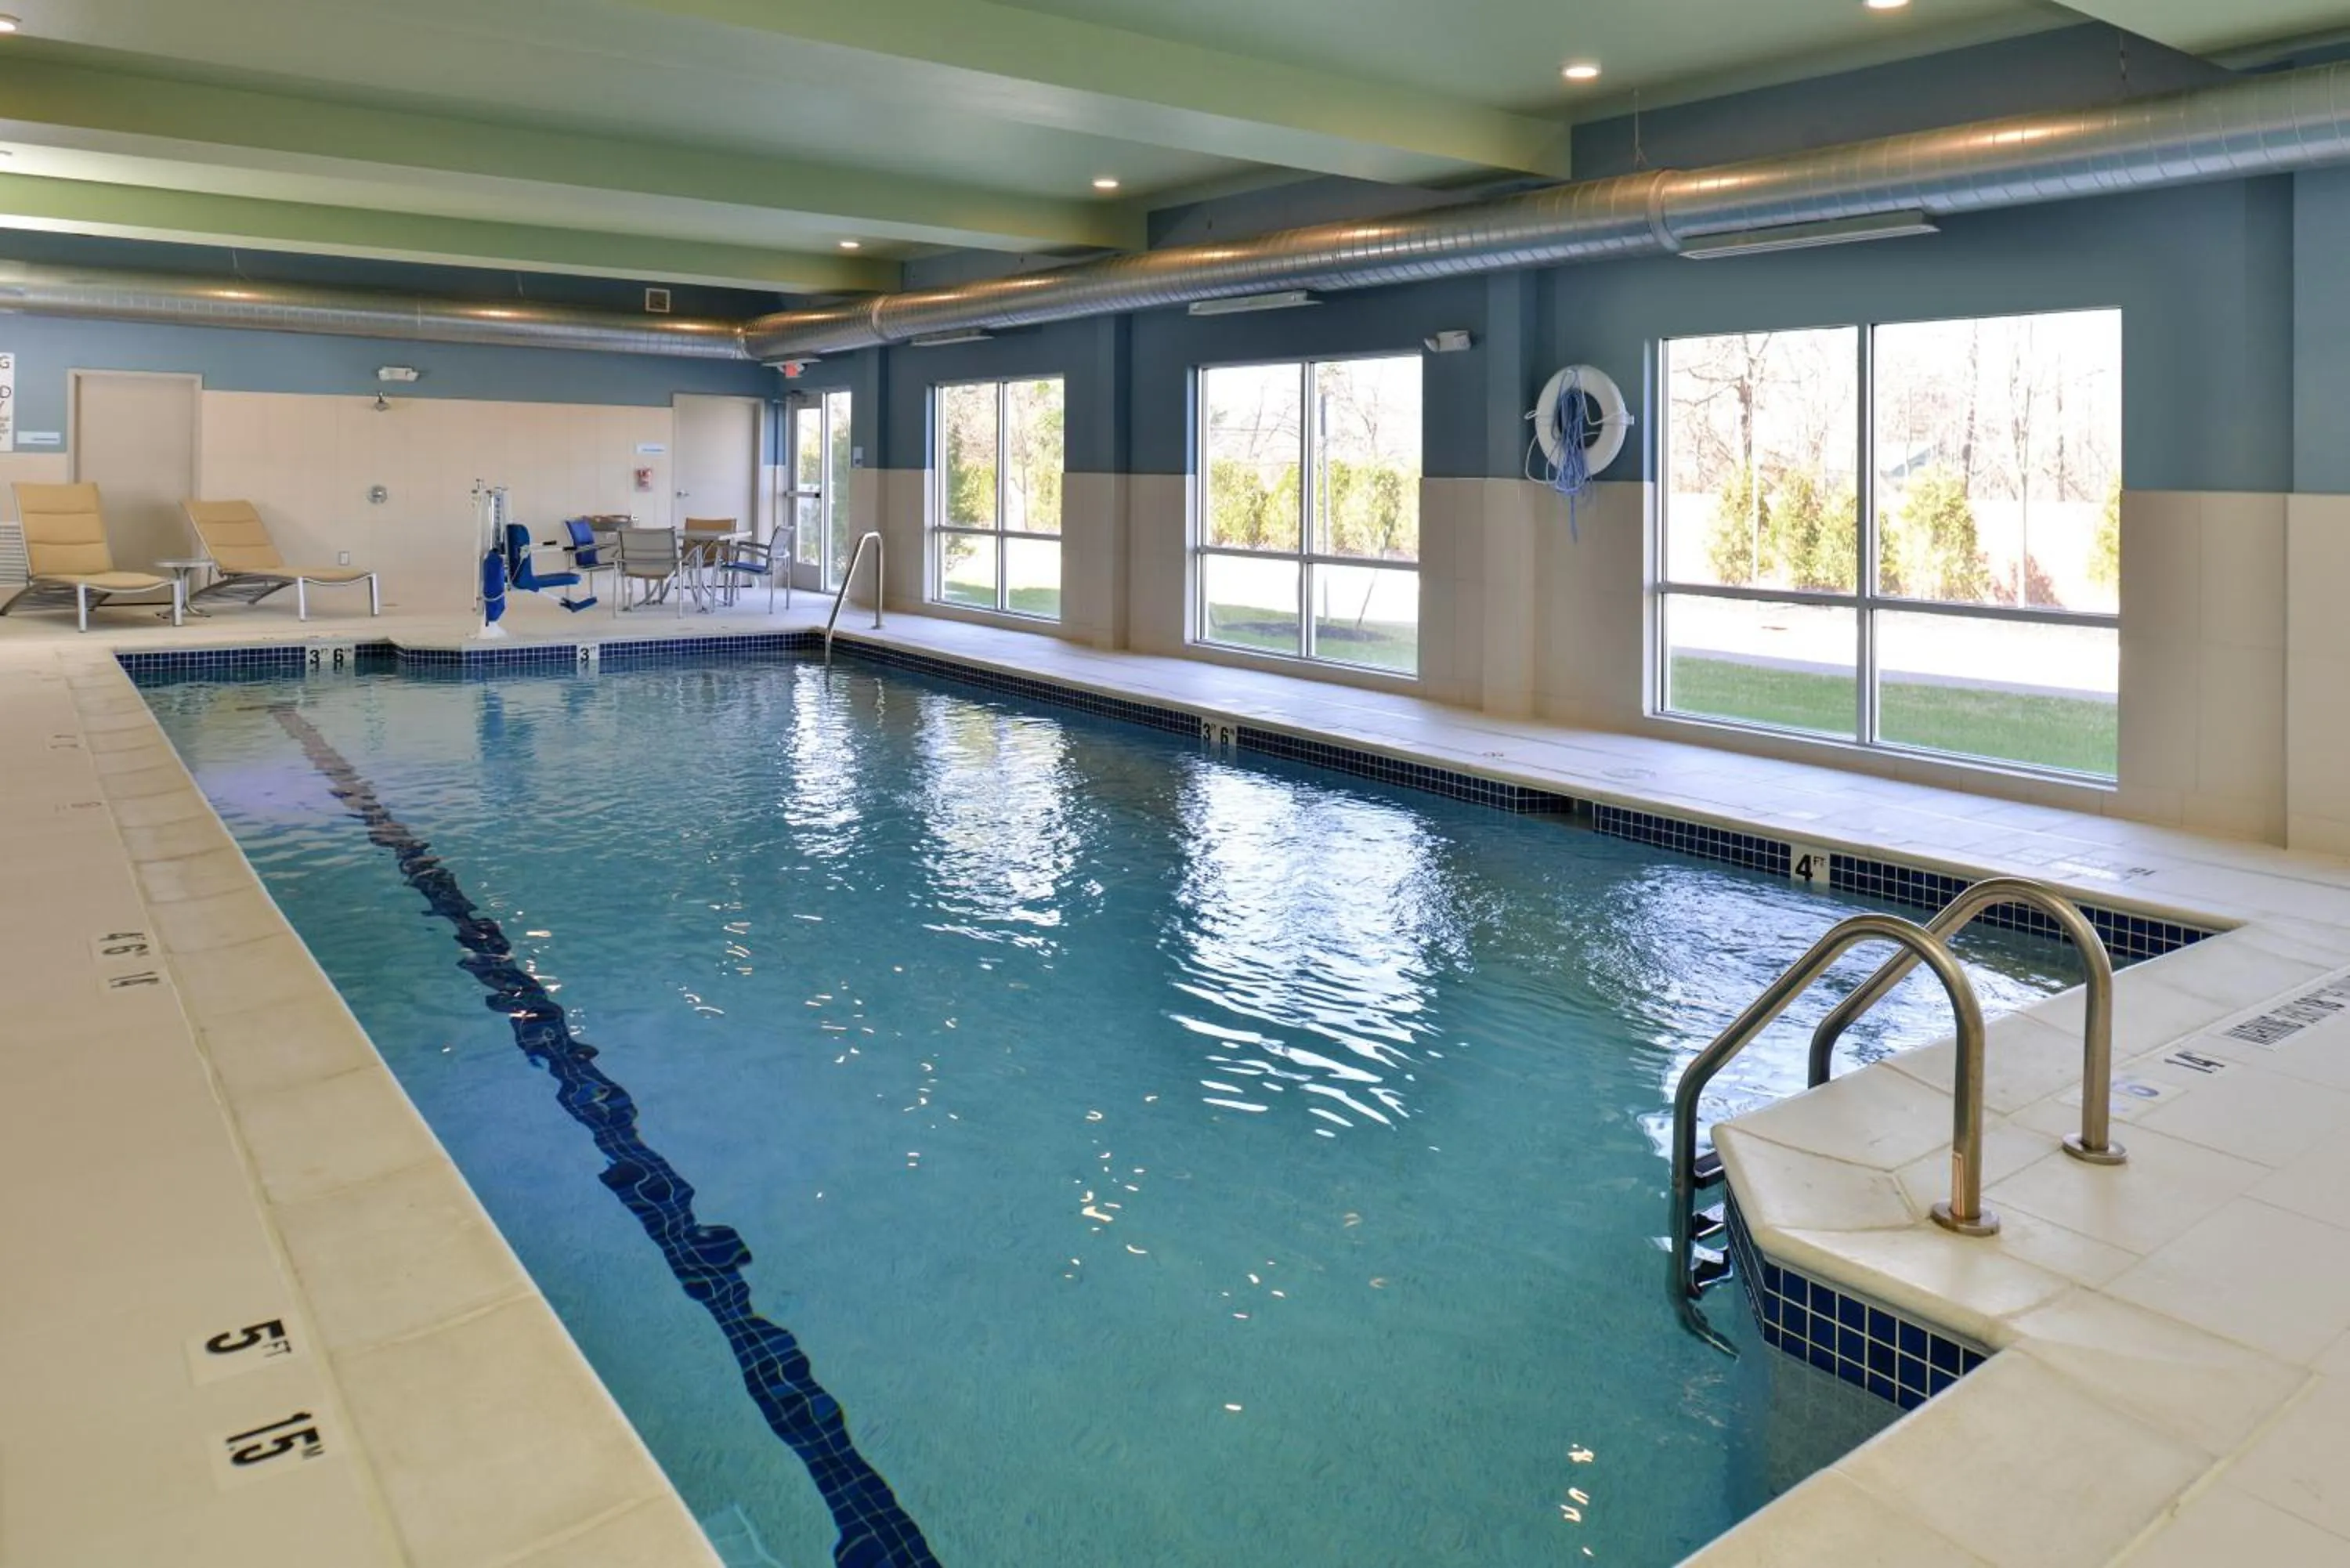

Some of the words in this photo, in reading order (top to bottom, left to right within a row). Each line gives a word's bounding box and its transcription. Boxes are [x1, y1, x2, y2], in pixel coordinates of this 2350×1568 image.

[309, 649, 320, 663] 3
[333, 648, 344, 662] 6
[580, 648, 590, 661] 3
[1202, 723, 1211, 740] 3
[1220, 726, 1229, 745] 6
[1795, 854, 1813, 881] 4
[205, 1319, 286, 1354] 5
[260, 1339, 292, 1358] FT
